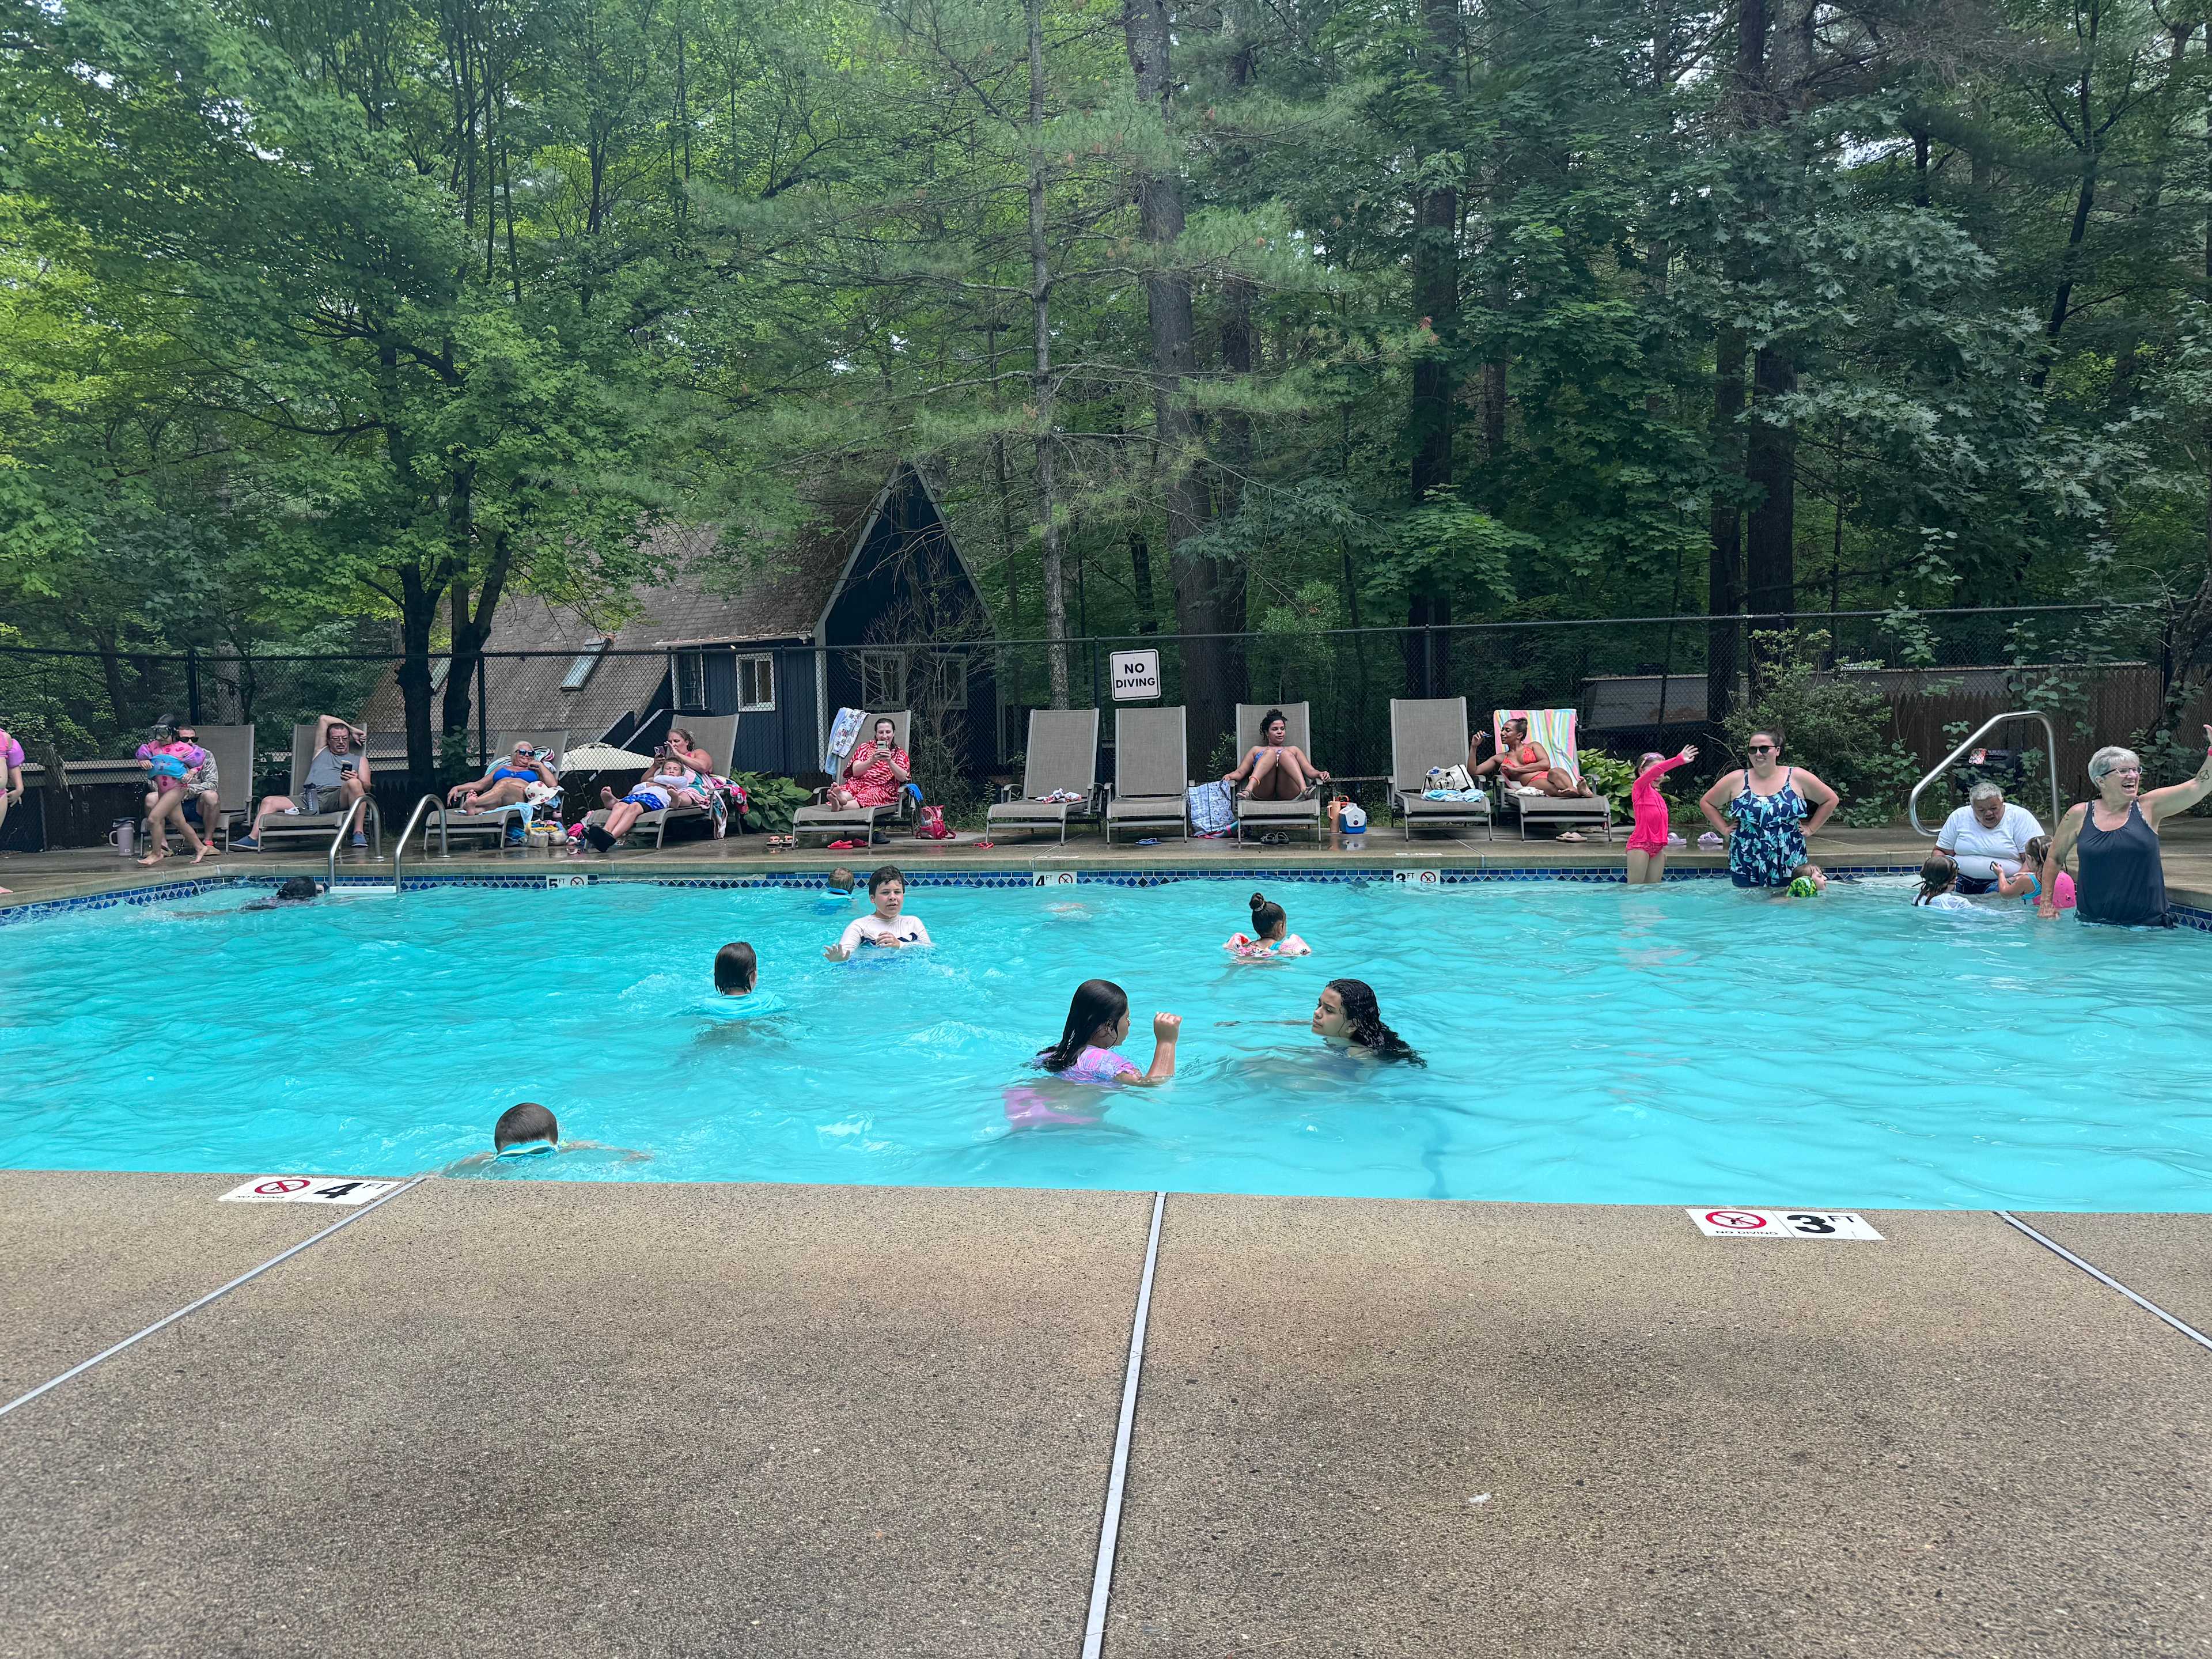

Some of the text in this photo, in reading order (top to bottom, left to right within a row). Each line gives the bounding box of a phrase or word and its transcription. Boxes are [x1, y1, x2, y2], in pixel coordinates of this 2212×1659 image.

[1124, 663, 1145, 674] NO
[1116, 677, 1156, 688] DIVING
[549, 878, 558, 888] 5
[1036, 876, 1046, 886] 4
[313, 1183, 363, 1199] 4
[1787, 1215, 1835, 1233] 3
